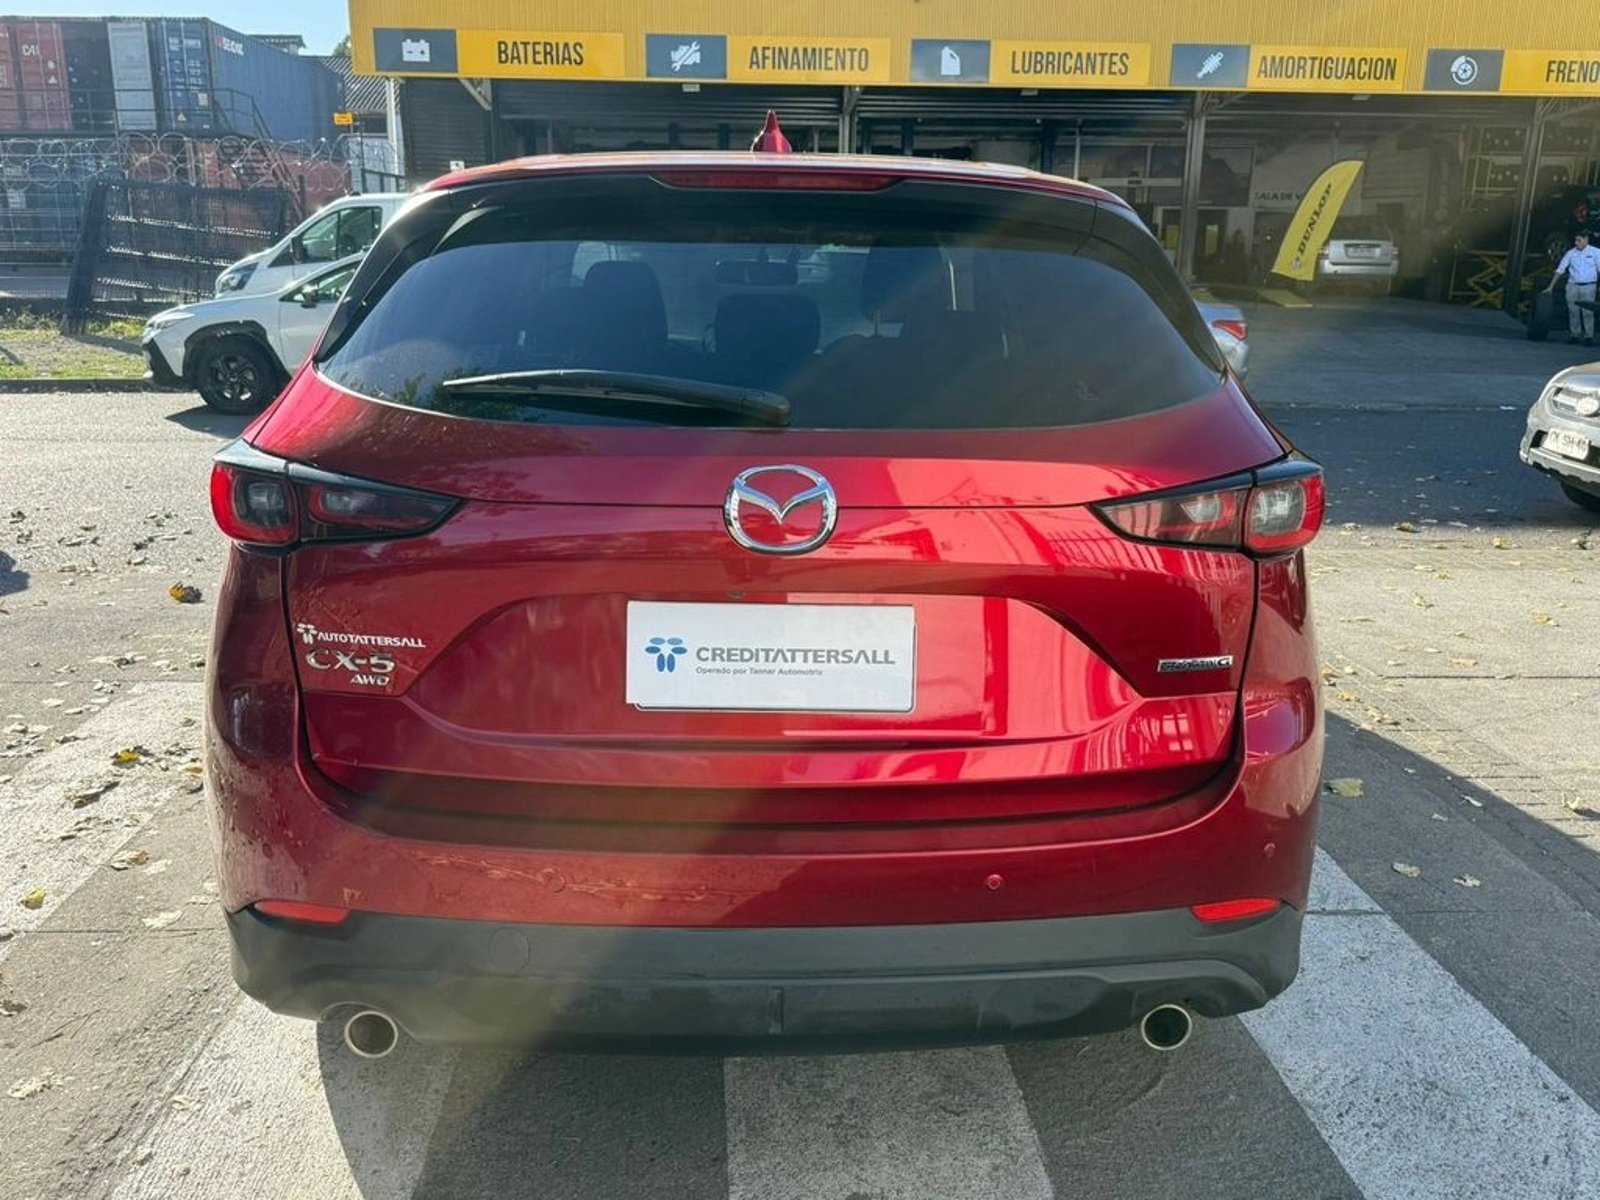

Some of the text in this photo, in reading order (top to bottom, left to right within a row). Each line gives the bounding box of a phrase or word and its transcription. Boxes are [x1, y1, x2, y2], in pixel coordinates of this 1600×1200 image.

[497, 40, 584, 66] BATERIAS
[749, 46, 869, 71] AFINAMIENTO
[1011, 50, 1129, 76] LUBRICANTES
[1257, 55, 1398, 81] AMORTIGUACION
[1545, 60, 1600, 83] FRENO
[1298, 183, 1332, 255] DUNLOP
[317, 632, 426, 648] AUTOTATTERSALL
[305, 649, 395, 673] CX-5
[695, 647, 896, 664] CREDITATTERSALL
[349, 674, 390, 686] AWD
[695, 666, 731, 675] Operado
[732, 668, 747, 676] por
[749, 667, 776, 675] Tanner
